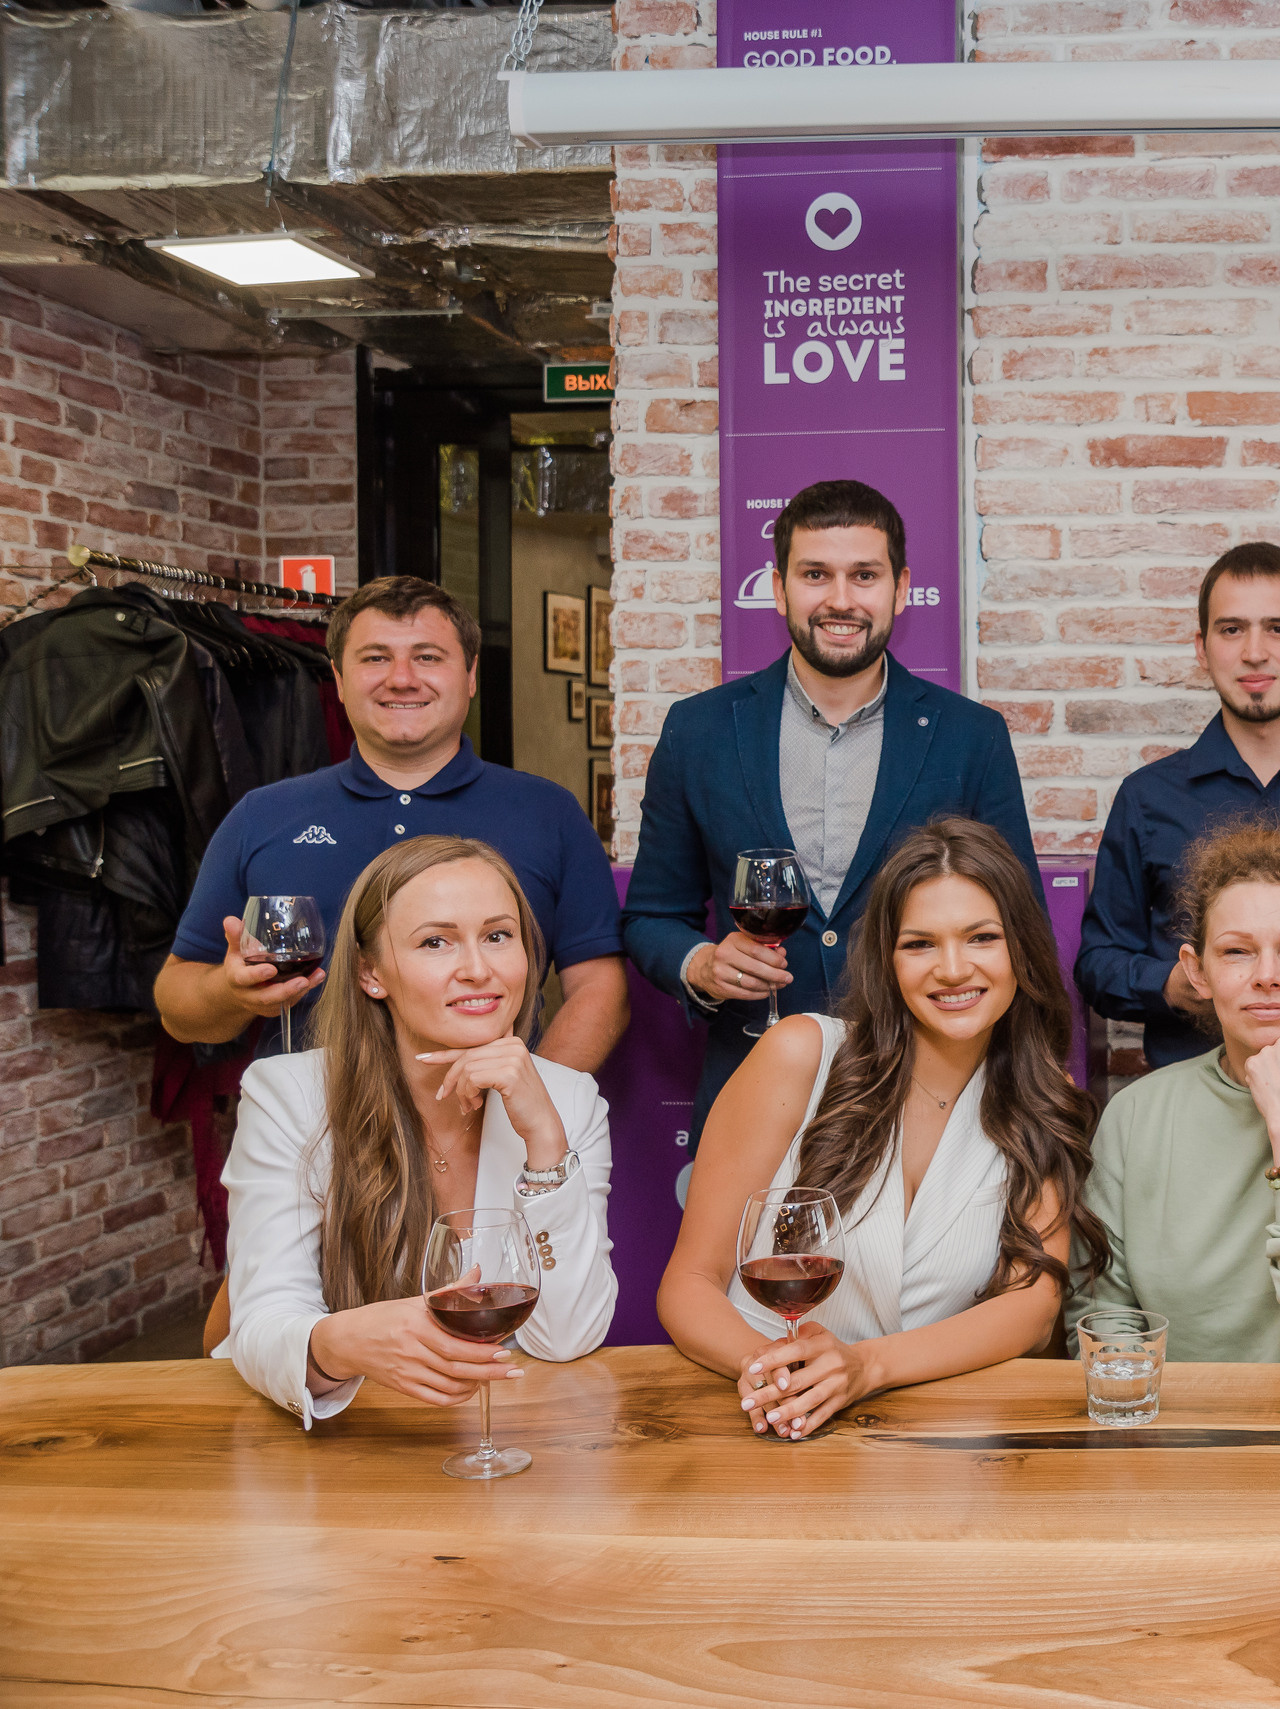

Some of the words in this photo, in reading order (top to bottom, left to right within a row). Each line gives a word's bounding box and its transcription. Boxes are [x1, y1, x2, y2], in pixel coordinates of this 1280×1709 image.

[744, 31, 780, 42] HOUSE
[782, 29, 809, 40] RULE
[810, 28, 823, 38] #1
[743, 48, 816, 68] GOOD
[822, 45, 897, 67] FOOD.
[763, 269, 811, 293] The
[818, 269, 906, 292] secret
[764, 295, 905, 318] INGREDIENT
[764, 316, 786, 338] is
[806, 310, 906, 347] always
[764, 338, 906, 385] LOVE
[746, 498, 783, 509] HOUSE
